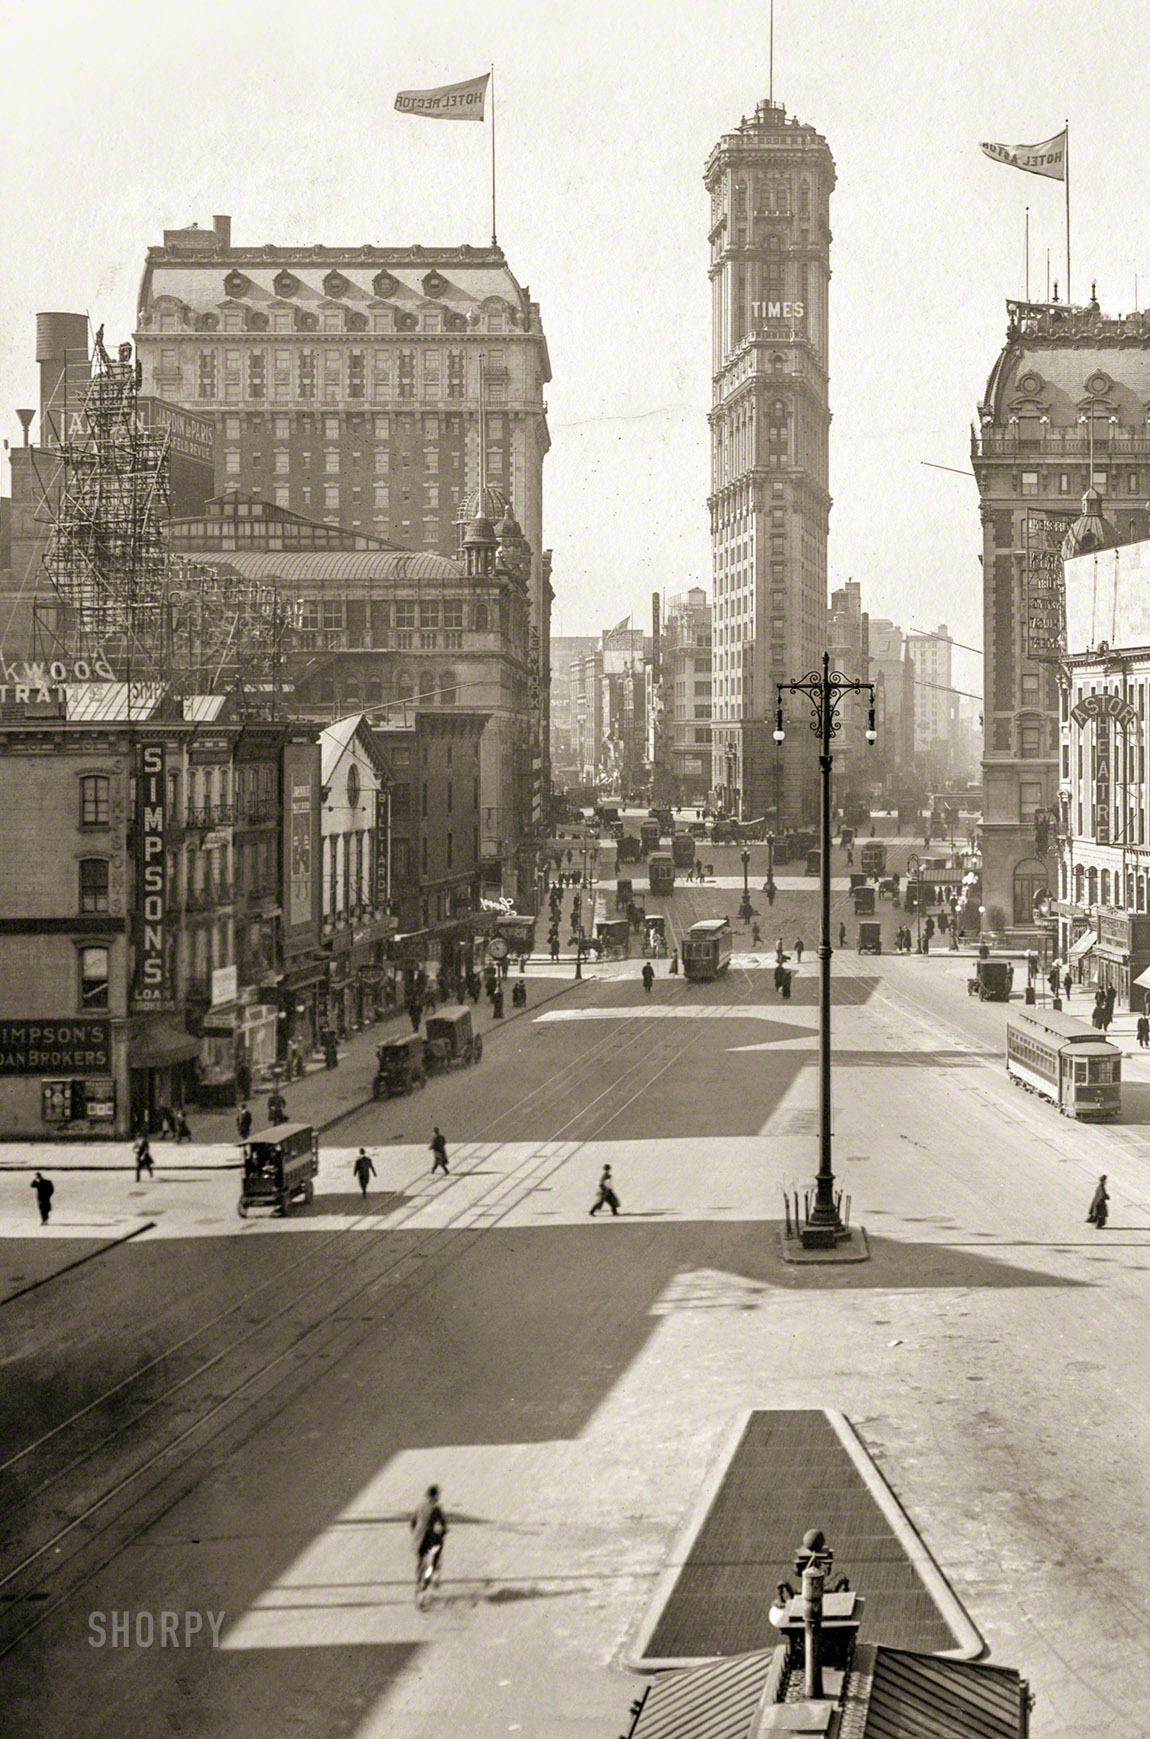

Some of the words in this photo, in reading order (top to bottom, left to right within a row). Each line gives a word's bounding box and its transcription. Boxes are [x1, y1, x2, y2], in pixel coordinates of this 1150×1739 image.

[752, 301, 804, 318] TIMES
[1073, 695, 1136, 727] ASTOR
[377, 793, 386, 900] BILLIARDS
[144, 748, 163, 984] SIMPSON'S
[28, 1049, 106, 1066] BROKERS
